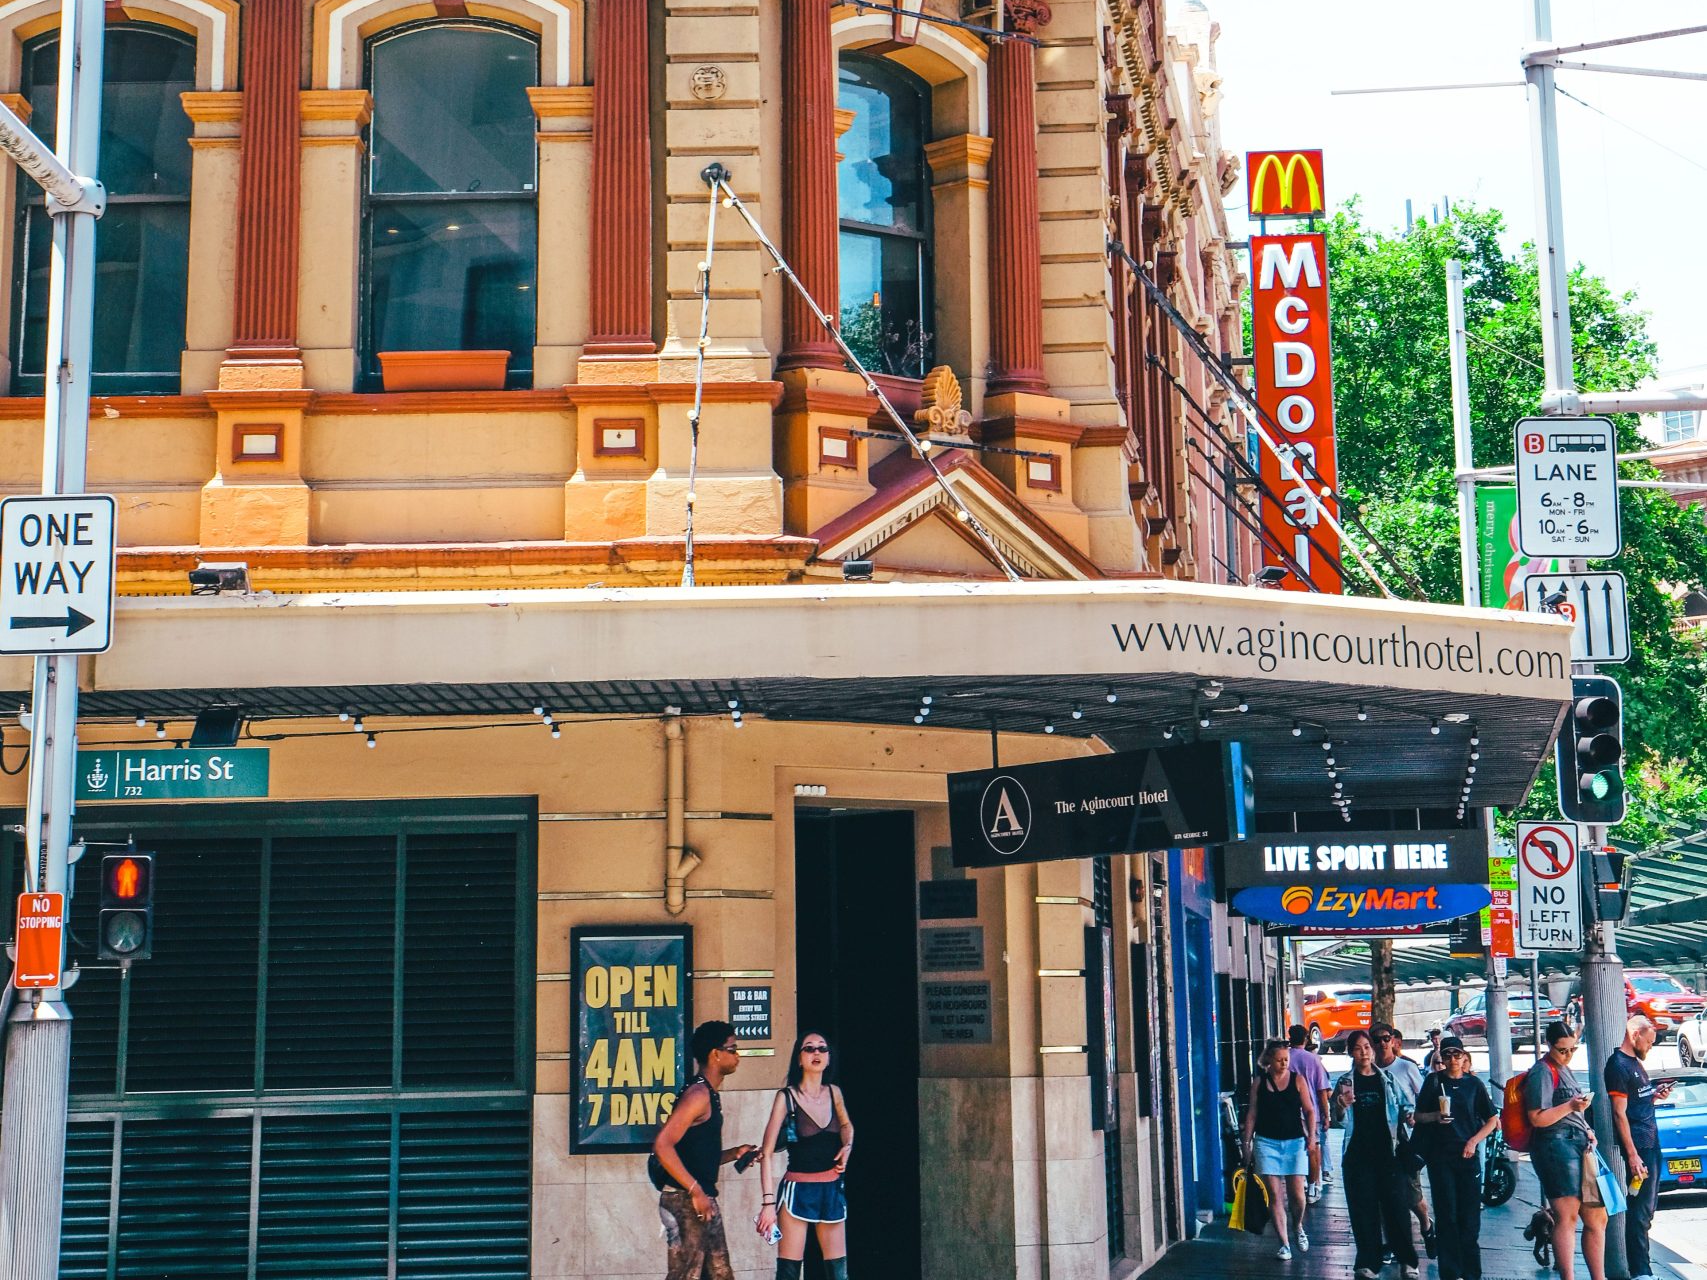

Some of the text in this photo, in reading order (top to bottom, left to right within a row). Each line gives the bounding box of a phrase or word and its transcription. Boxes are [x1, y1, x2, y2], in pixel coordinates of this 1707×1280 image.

[1534, 464, 1597, 481] LANE
[20, 513, 94, 547] ONE
[1484, 501, 1495, 539] merry
[14, 561, 96, 595] WAY
[1111, 620, 1566, 680] www.agincourthotel.com
[124, 756, 235, 782] Harris St
[124, 786, 143, 796] 732
[1054, 789, 1169, 815] The Agincourt Hotel
[1264, 844, 1448, 872] LIVE SPORT HERE
[32, 898, 51, 913] NO
[1316, 885, 1440, 918] EzyMart
[1493, 890, 1509, 898] BUS
[1533, 886, 1565, 905] NO
[19, 916, 61, 929] STOPPING
[1530, 910, 1571, 923] LEFT
[1528, 928, 1573, 942] TURN
[585, 965, 678, 1009] OPEN
[733, 990, 768, 1001] TAB & BAR
[613, 1011, 651, 1034] TILL
[585, 1038, 676, 1088] 4AM
[588, 1092, 678, 1127] 7 DAYS
